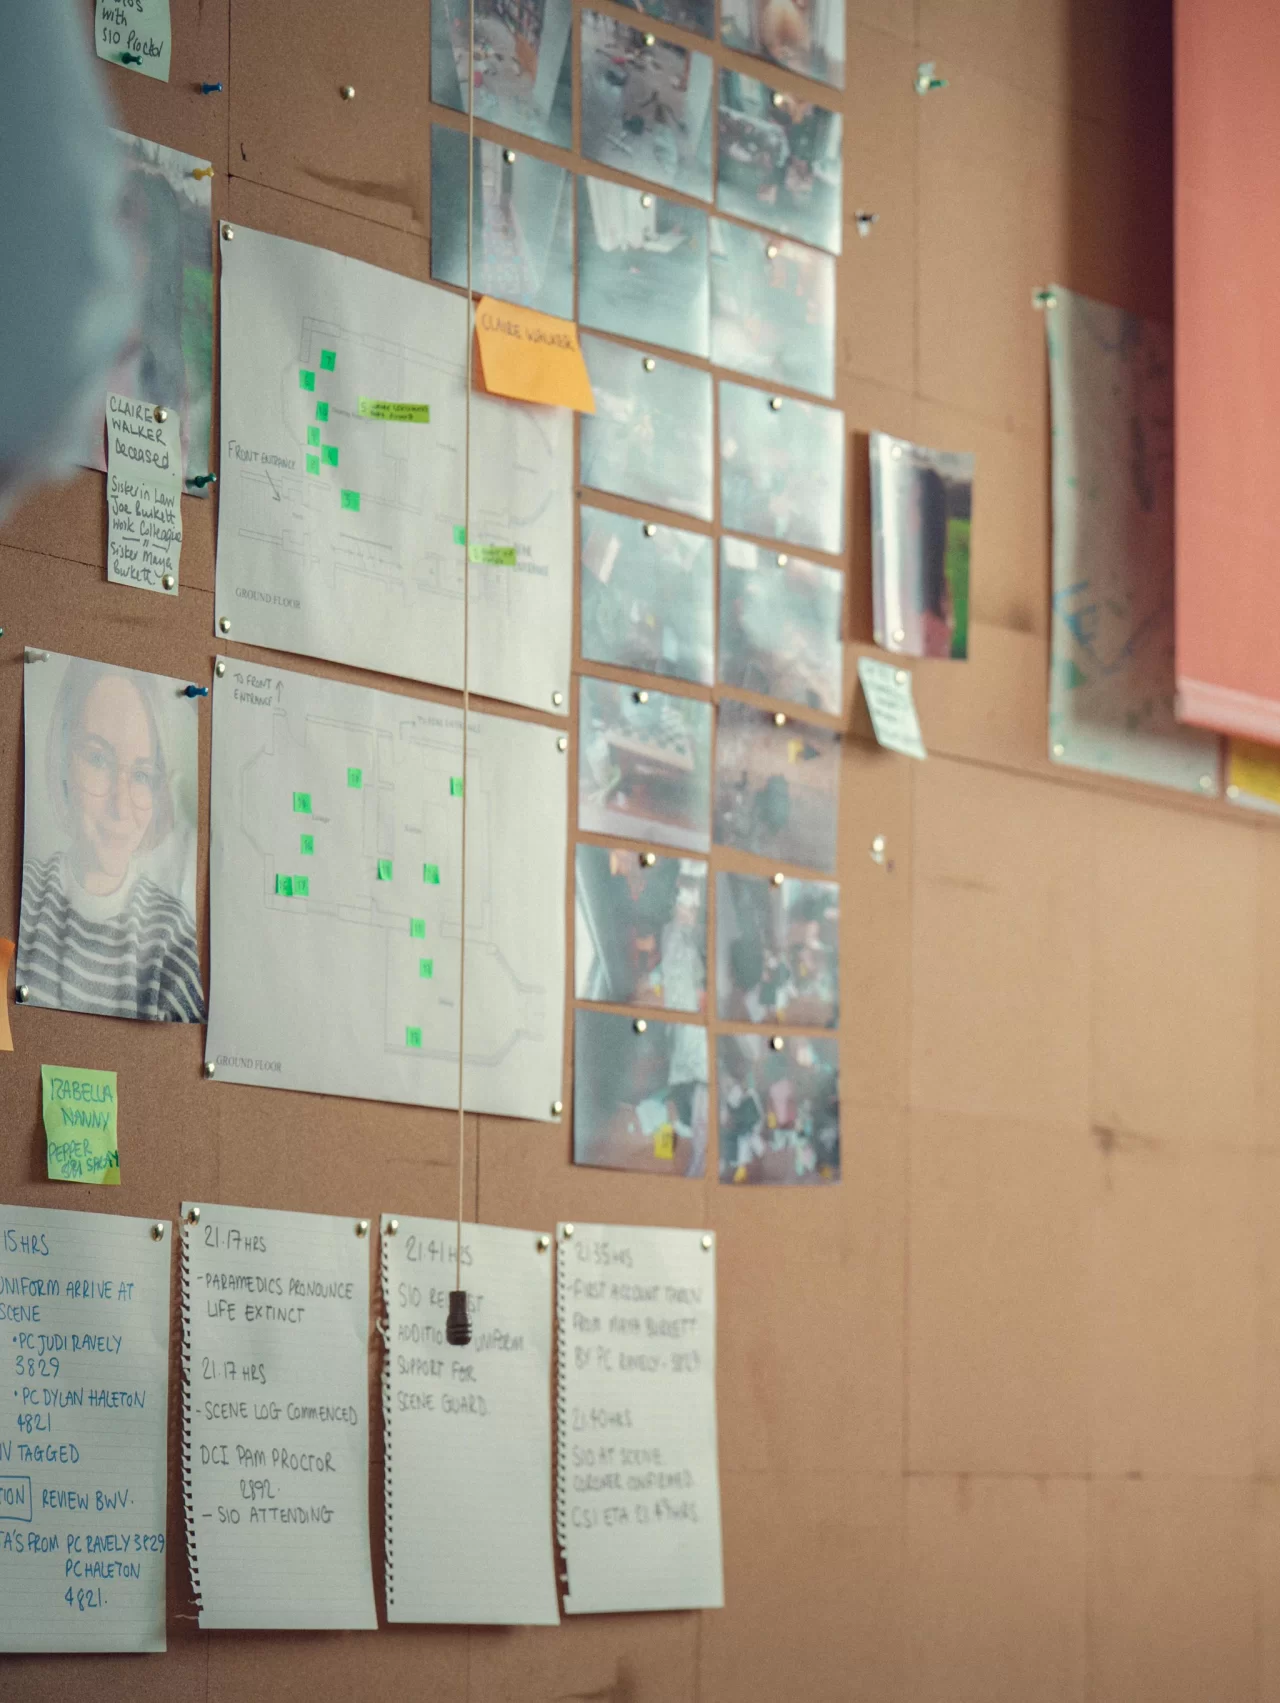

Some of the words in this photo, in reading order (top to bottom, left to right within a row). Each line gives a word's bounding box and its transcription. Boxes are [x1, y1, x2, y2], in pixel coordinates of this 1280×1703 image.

[102, 7, 127, 26] with
[110, 396, 152, 423] CLAIRE
[112, 418, 166, 446] WALKER
[228, 440, 259, 462] FRONT
[235, 587, 271, 604] GROUND
[216, 1055, 254, 1069] GROUND
[255, 1060, 282, 1072] FLOOR
[61, 1107, 110, 1132] NANNY
[48, 1138, 92, 1164] PEPPER
[65, 1280, 113, 1299] ARRIVE
[118, 1281, 134, 1301] AT
[288, 1278, 354, 1300] PRONOUNCE
[207, 1299, 236, 1321] LIFE
[244, 1304, 306, 1324] EXTINCT
[71, 1333, 122, 1354] RAVELY
[15, 1355, 60, 1378] 3829
[242, 1363, 267, 1384] HRS
[254, 1401, 282, 1421] LOG
[17, 1412, 51, 1434] 4821
[17, 1444, 80, 1463] TAGGED
[200, 1444, 230, 1465] DCI
[235, 1444, 267, 1468] PAM
[271, 1447, 336, 1472] PROCTOR
[42, 1489, 89, 1510] REVIEW
[217, 1505, 241, 1524] SIO
[249, 1505, 335, 1524] ATTENDING
[27, 1531, 59, 1553] FROM
[66, 1534, 82, 1553] PC
[86, 1534, 131, 1553] RAVELY
[65, 1558, 82, 1578] PC
